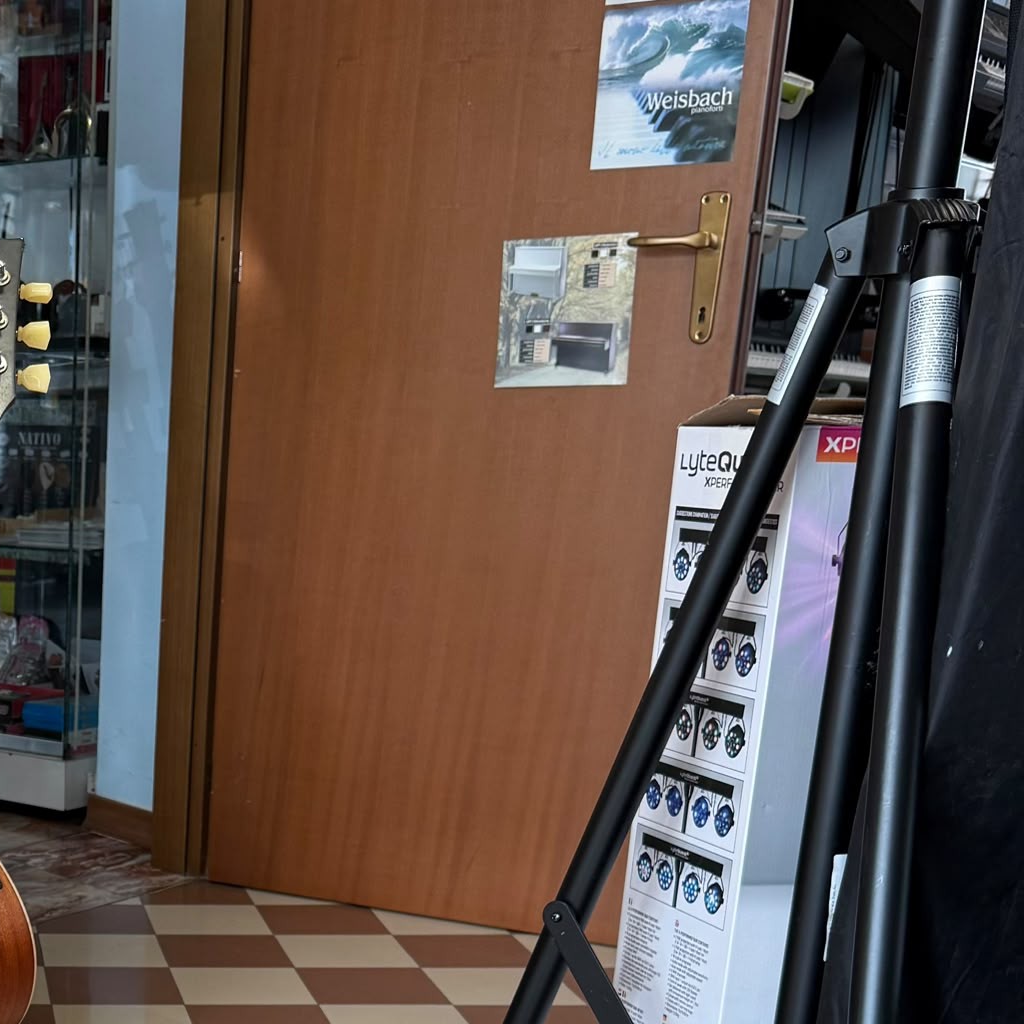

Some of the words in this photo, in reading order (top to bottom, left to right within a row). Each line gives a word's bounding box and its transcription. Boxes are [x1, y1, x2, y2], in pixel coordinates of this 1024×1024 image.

[647, 86, 733, 110] Weisbach
[680, 449, 744, 477] LyteQu
[704, 476, 733, 489] XPERF
